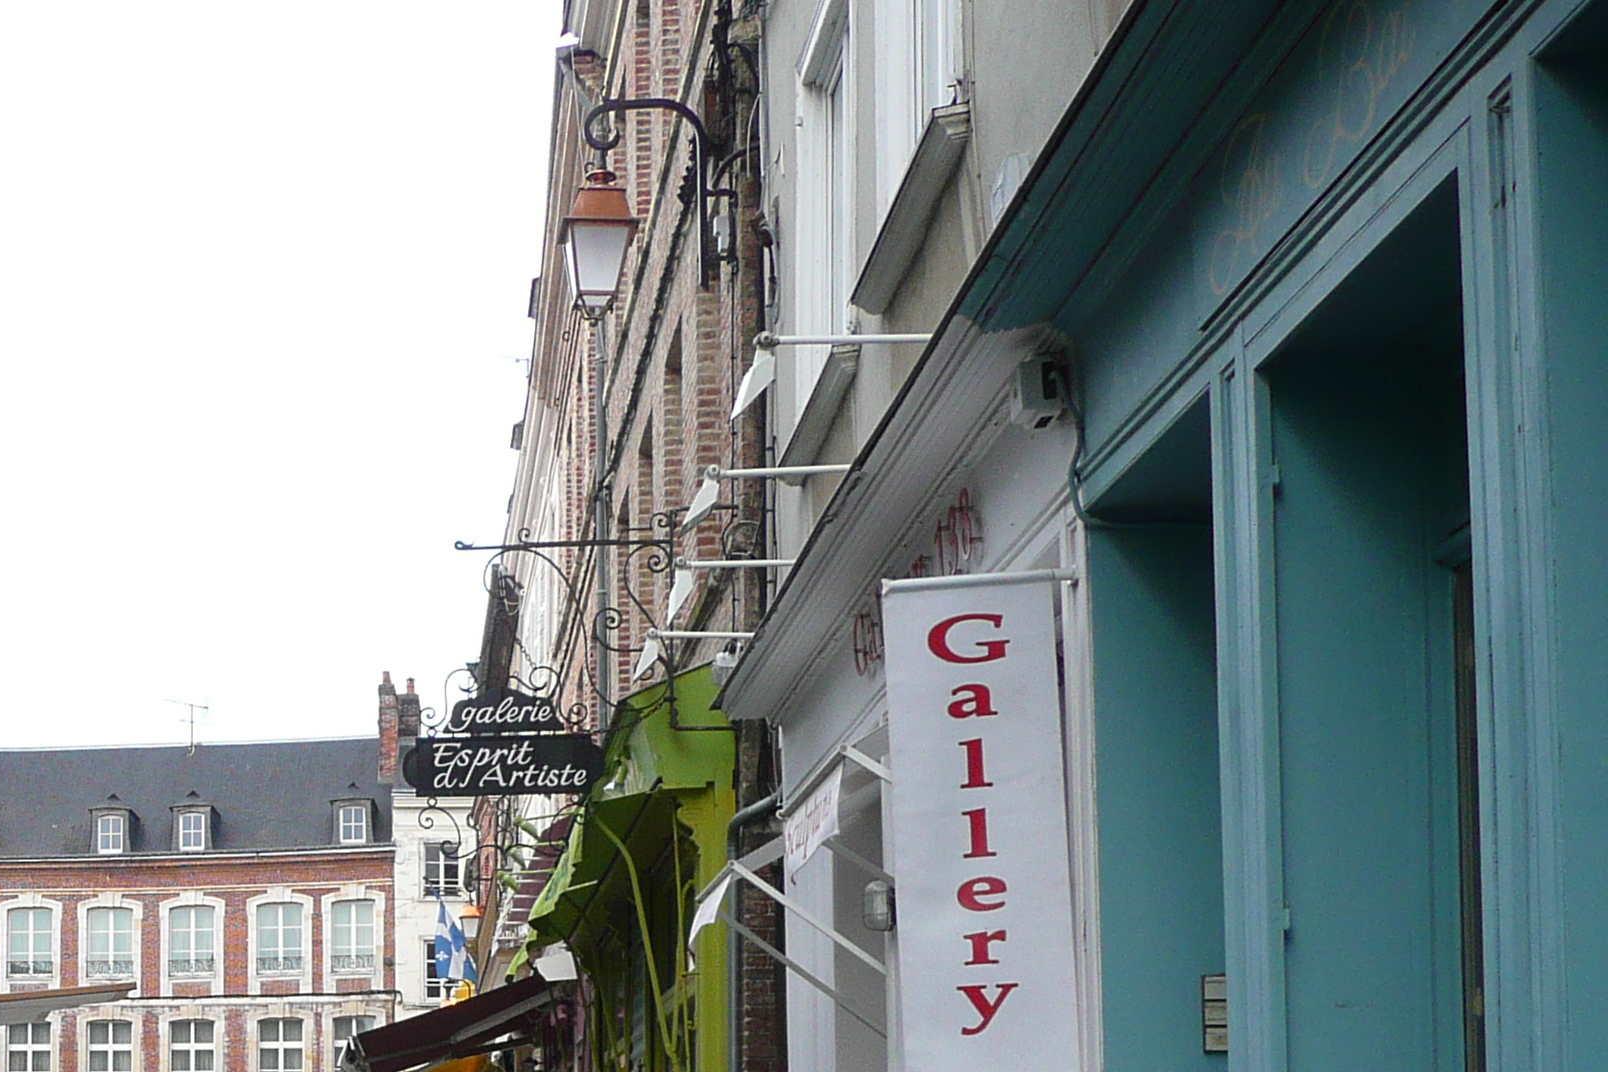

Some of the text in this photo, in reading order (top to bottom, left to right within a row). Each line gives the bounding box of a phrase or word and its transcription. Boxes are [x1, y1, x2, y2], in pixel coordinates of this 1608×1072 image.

[448, 696, 553, 731] galerie
[432, 740, 534, 787] Esprit
[927, 612, 1020, 1036] Gallery
